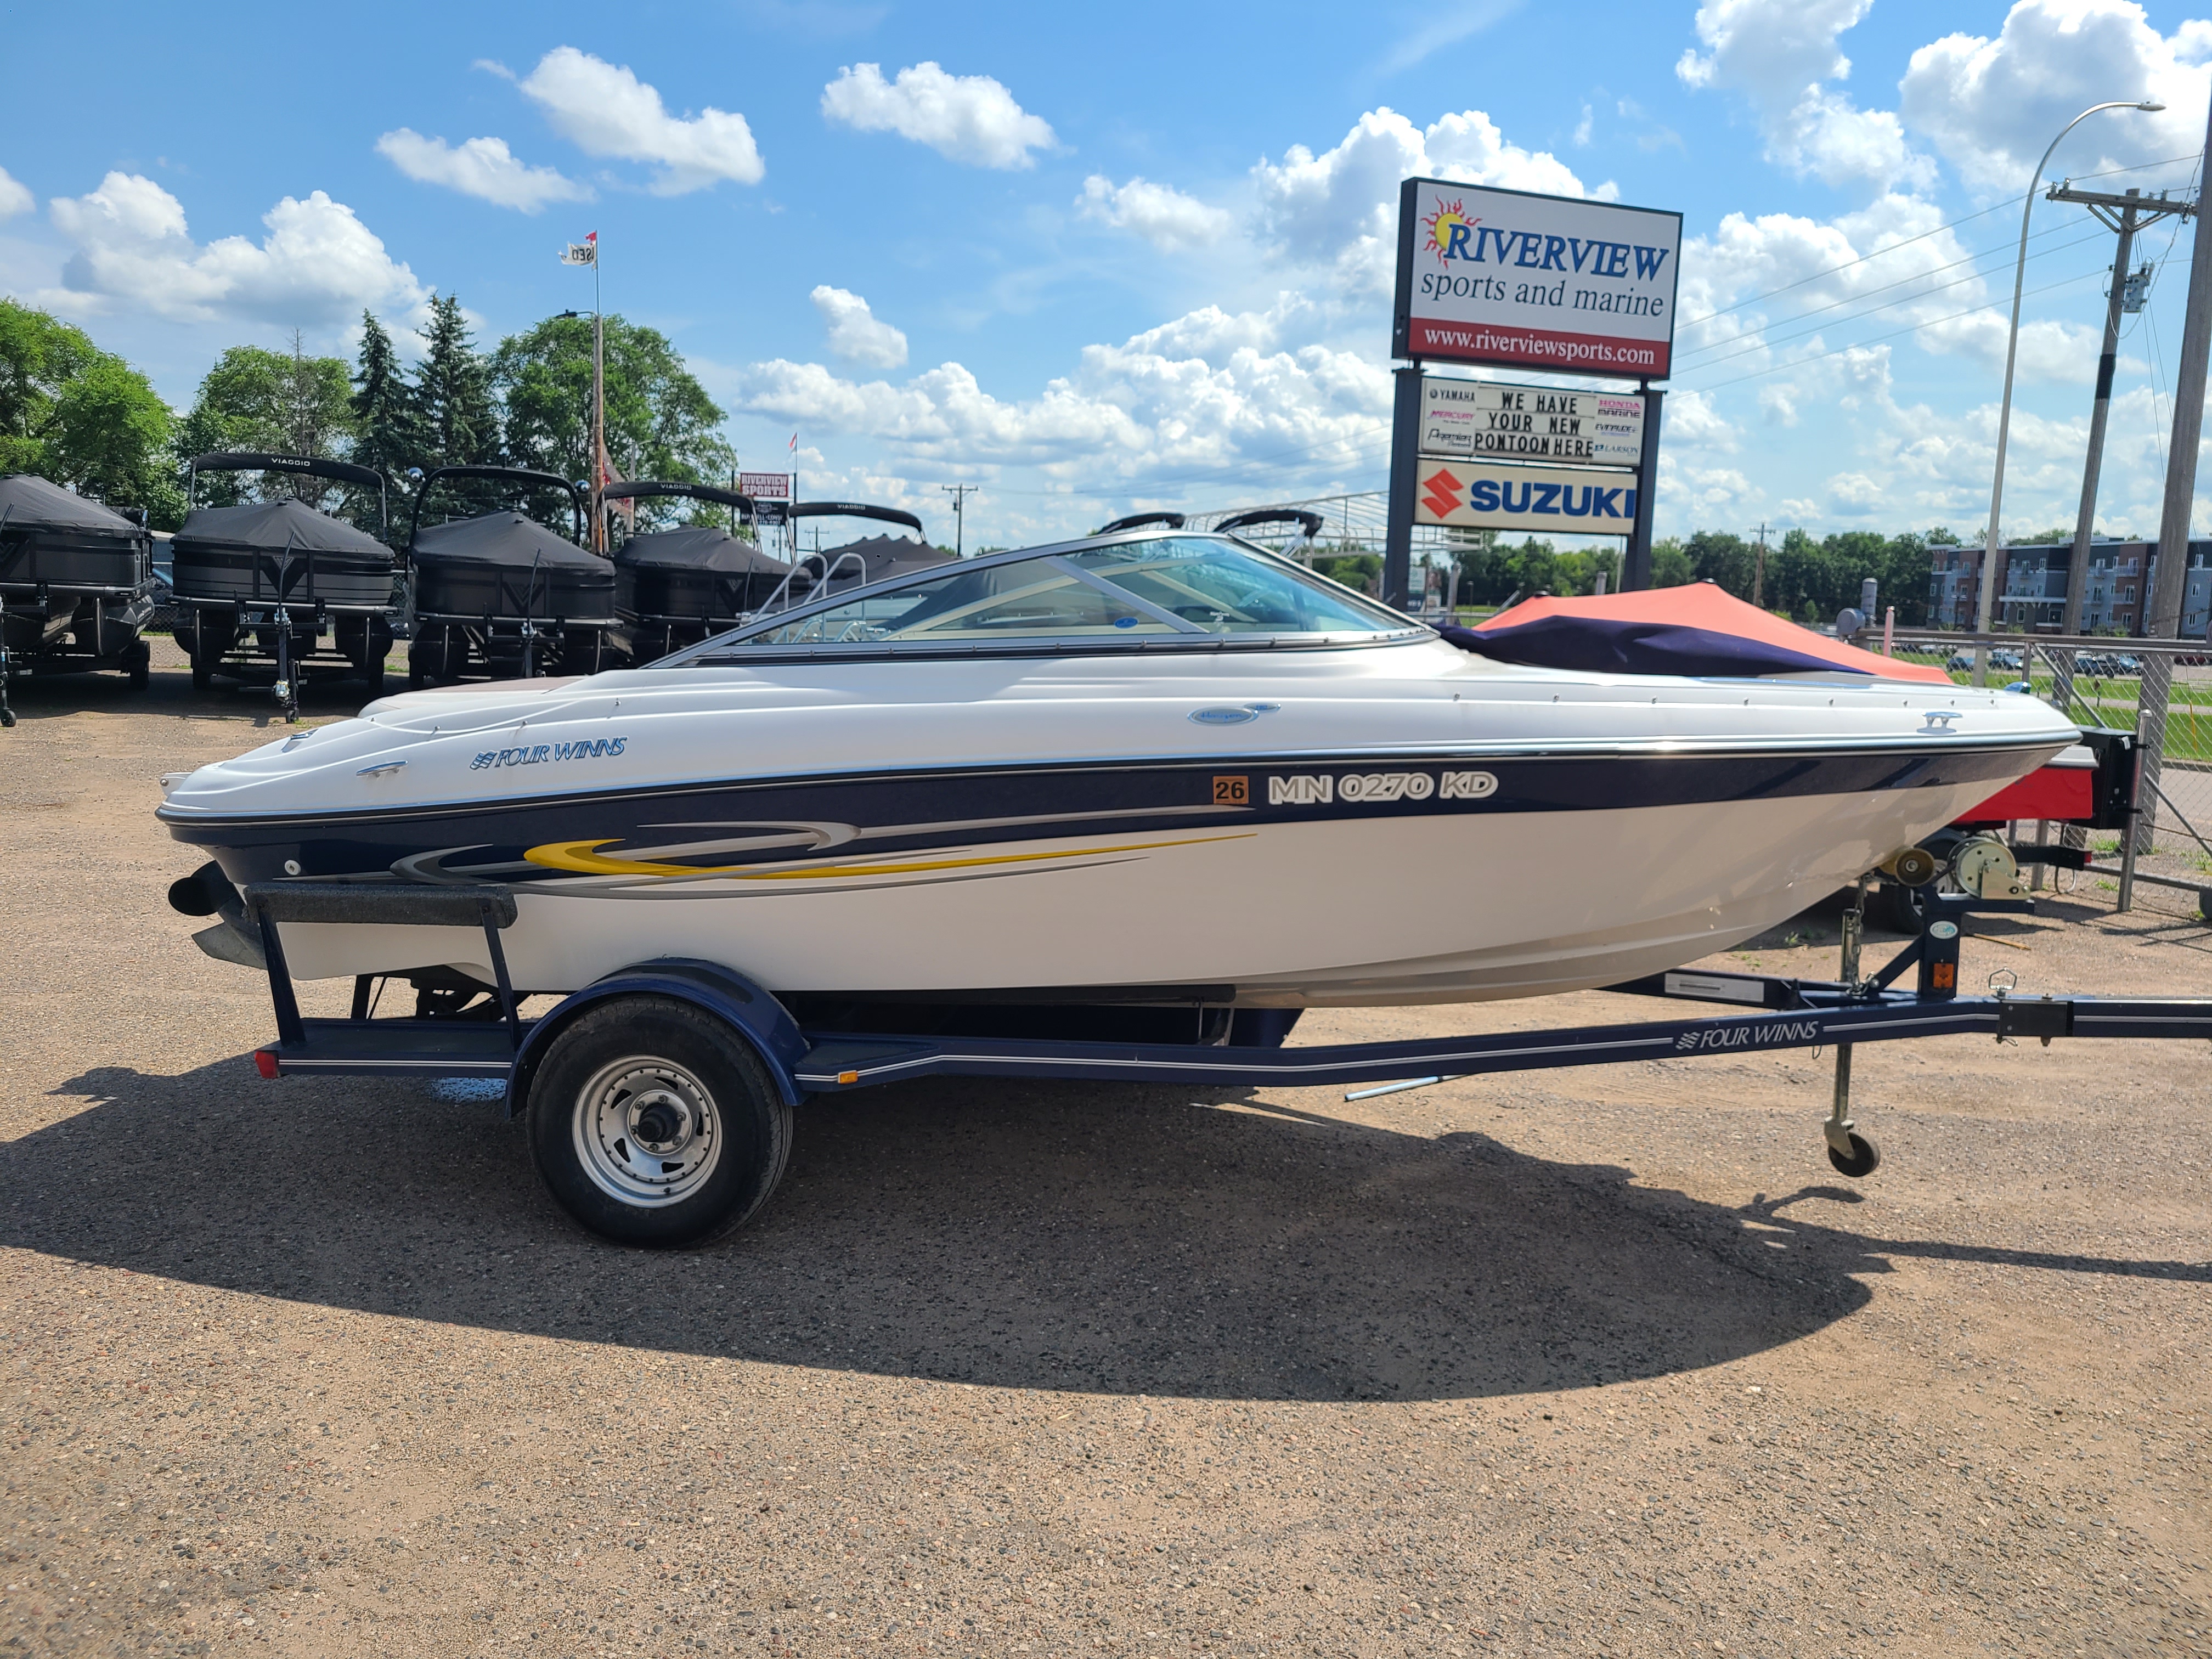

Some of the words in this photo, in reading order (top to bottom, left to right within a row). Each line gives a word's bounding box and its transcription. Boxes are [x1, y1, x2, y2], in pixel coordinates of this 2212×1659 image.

[1443, 223, 1669, 281] RIVERVIEW
[1421, 273, 1506, 301] sports
[1515, 280, 1566, 306] and
[1572, 286, 1663, 317] marine
[1425, 329, 1655, 365] www.riverviewsports.com
[1440, 389, 1476, 403] YAMAHA
[1502, 392, 1524, 410] WE
[1537, 394, 1577, 414] HAVE
[1599, 399, 1640, 409] HONDA
[1430, 410, 1475, 420] MERCURY
[1489, 412, 1532, 431] YOUR
[1549, 416, 1580, 436] NEW
[1598, 409, 1641, 419] MARINE
[1475, 433, 1549, 455] PONTOON
[1554, 438, 1593, 456] HERE
[271, 458, 311, 467] VIAGGIO
[742, 474, 787, 485] RIVERVIEW
[742, 485, 787, 496] SPORTS
[1470, 479, 1635, 518] SUZUKI
[495, 743, 550, 768] FOUR
[554, 736, 628, 761] WINNS
[1215, 781, 1245, 800] 26
[1269, 775, 1333, 804] MN
[1338, 772, 1435, 802] 0270
[1439, 771, 1498, 799] KD
[1699, 1026, 1751, 1049] FOUR
[1755, 1020, 1819, 1043] WINNS
